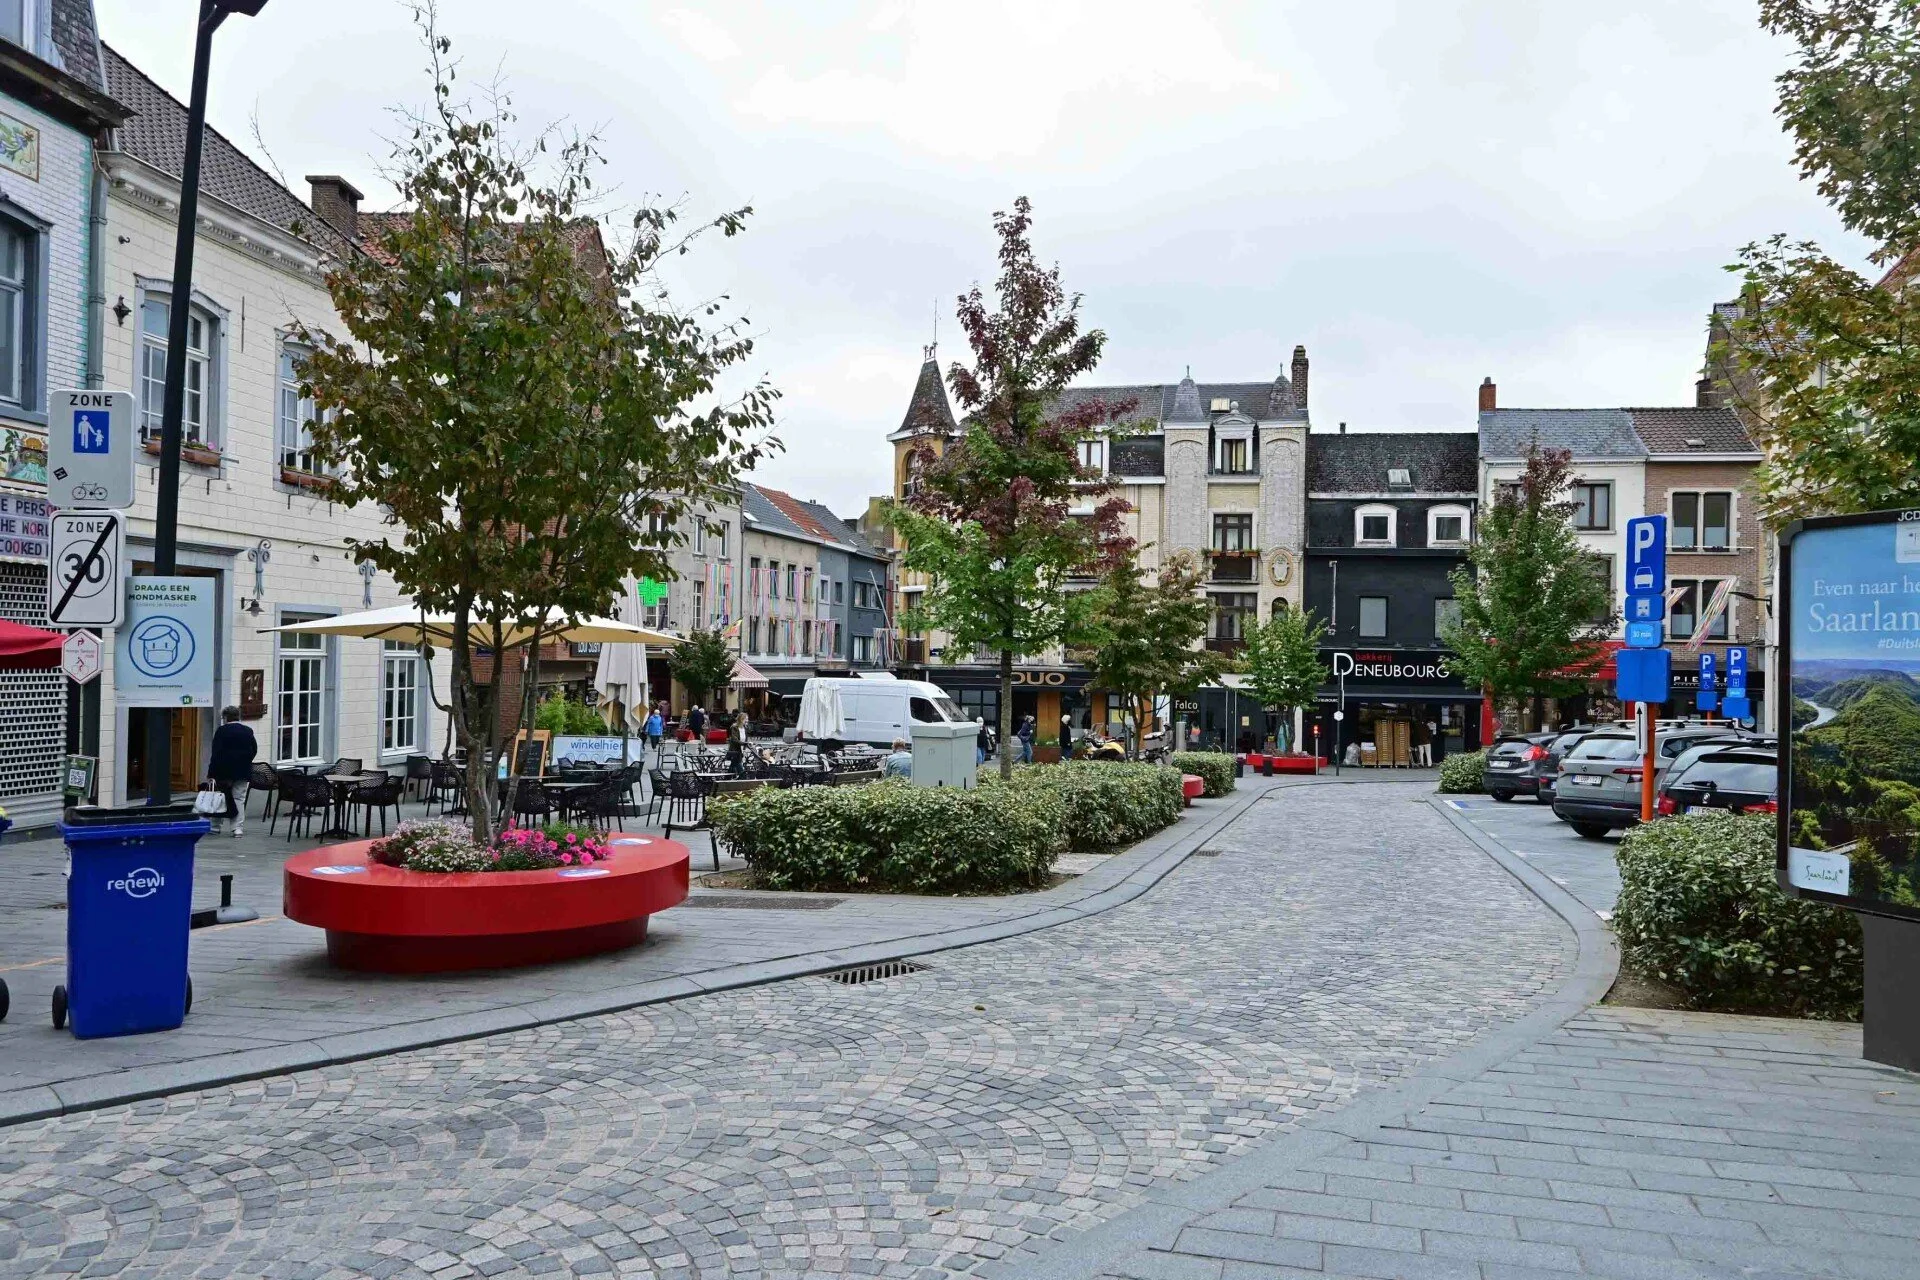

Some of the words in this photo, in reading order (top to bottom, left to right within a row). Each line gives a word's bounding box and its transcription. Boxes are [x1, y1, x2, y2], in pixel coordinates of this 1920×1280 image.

[69, 394, 113, 407] ZONE
[66, 521, 104, 533] ZONE
[1634, 522, 1655, 564] P
[64, 553, 105, 584] 30
[134, 584, 167, 592] DRAAG
[1814, 579, 1853, 596] Even
[1860, 582, 1897, 595] naar
[128, 593, 197, 602] MONDMASKER
[1355, 652, 1392, 663] bakkerij
[1702, 655, 1711, 670] P
[1731, 650, 1742, 665] P
[1333, 652, 1450, 678] DENEUBOURG
[1175, 700, 1198, 710] Falco
[570, 739, 624, 751] winkelhier
[107, 873, 165, 891] renewi
